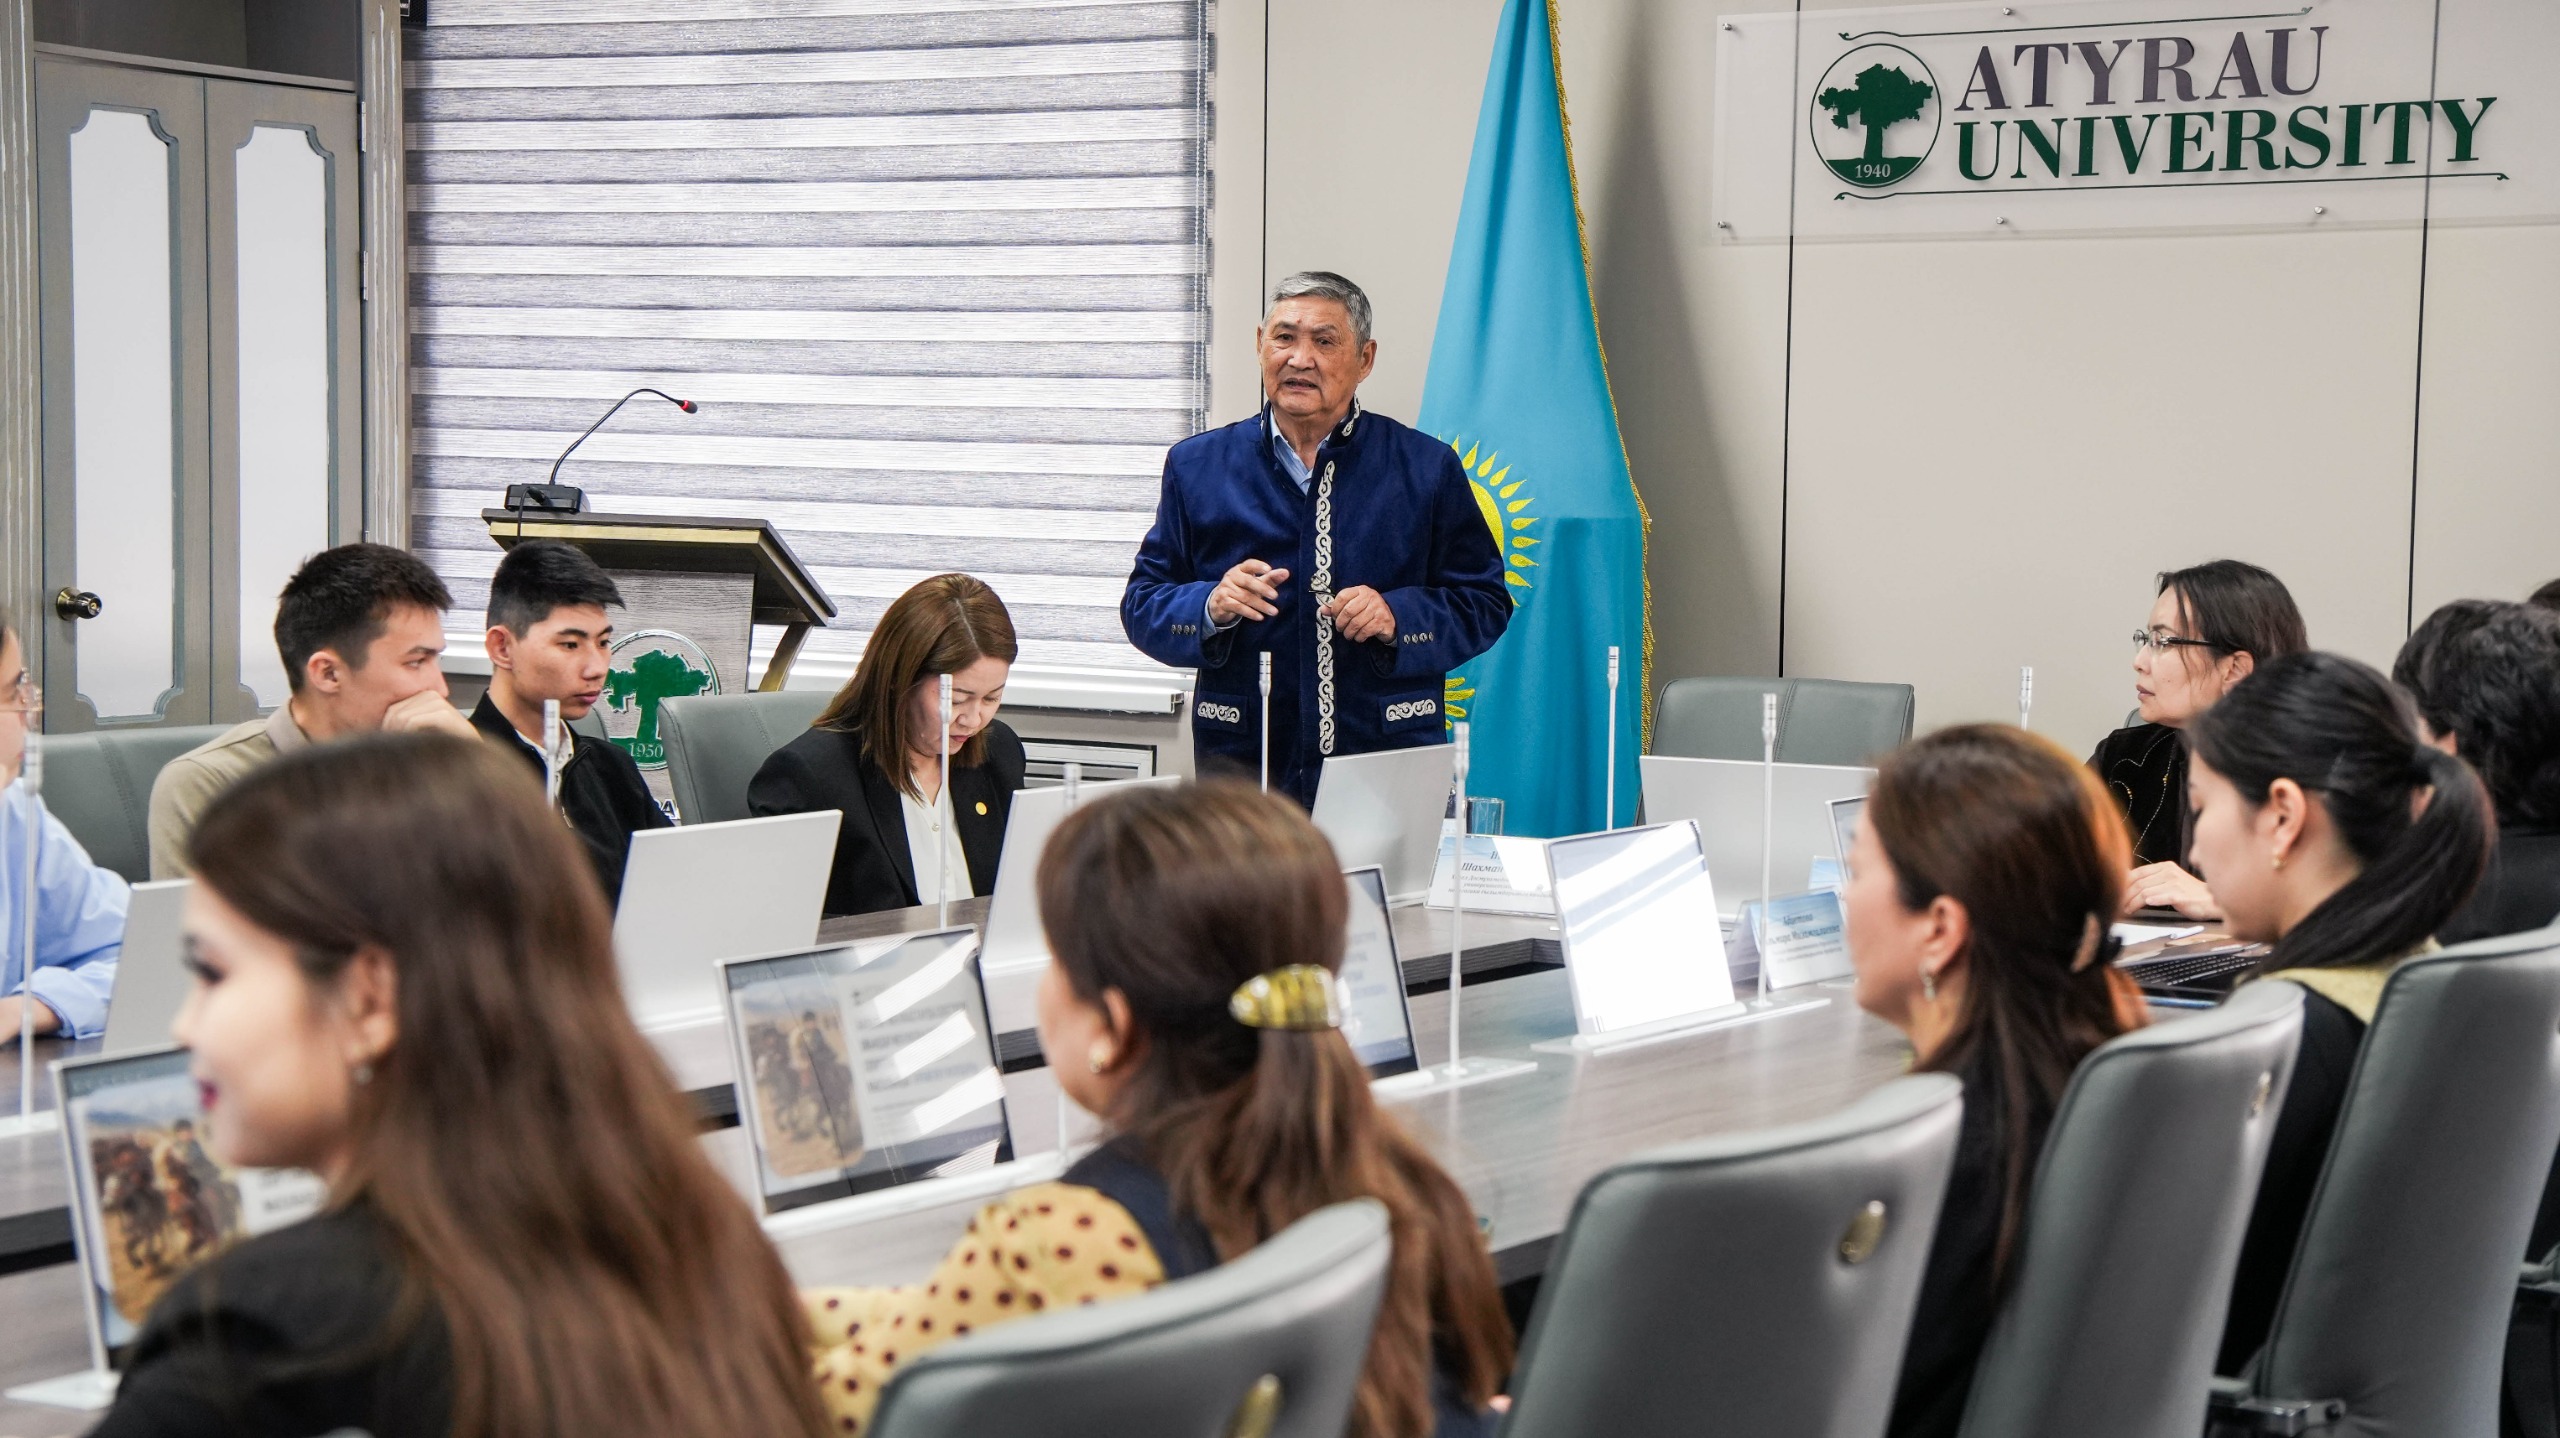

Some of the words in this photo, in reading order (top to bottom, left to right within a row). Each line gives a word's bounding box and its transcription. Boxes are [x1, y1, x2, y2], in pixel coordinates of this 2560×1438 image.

[1953, 25, 2330, 111] ATYRAU
[1953, 96, 2498, 181] UNIVERSITY
[1855, 163, 1892, 179] 1940
[628, 742, 664, 758] 1950
